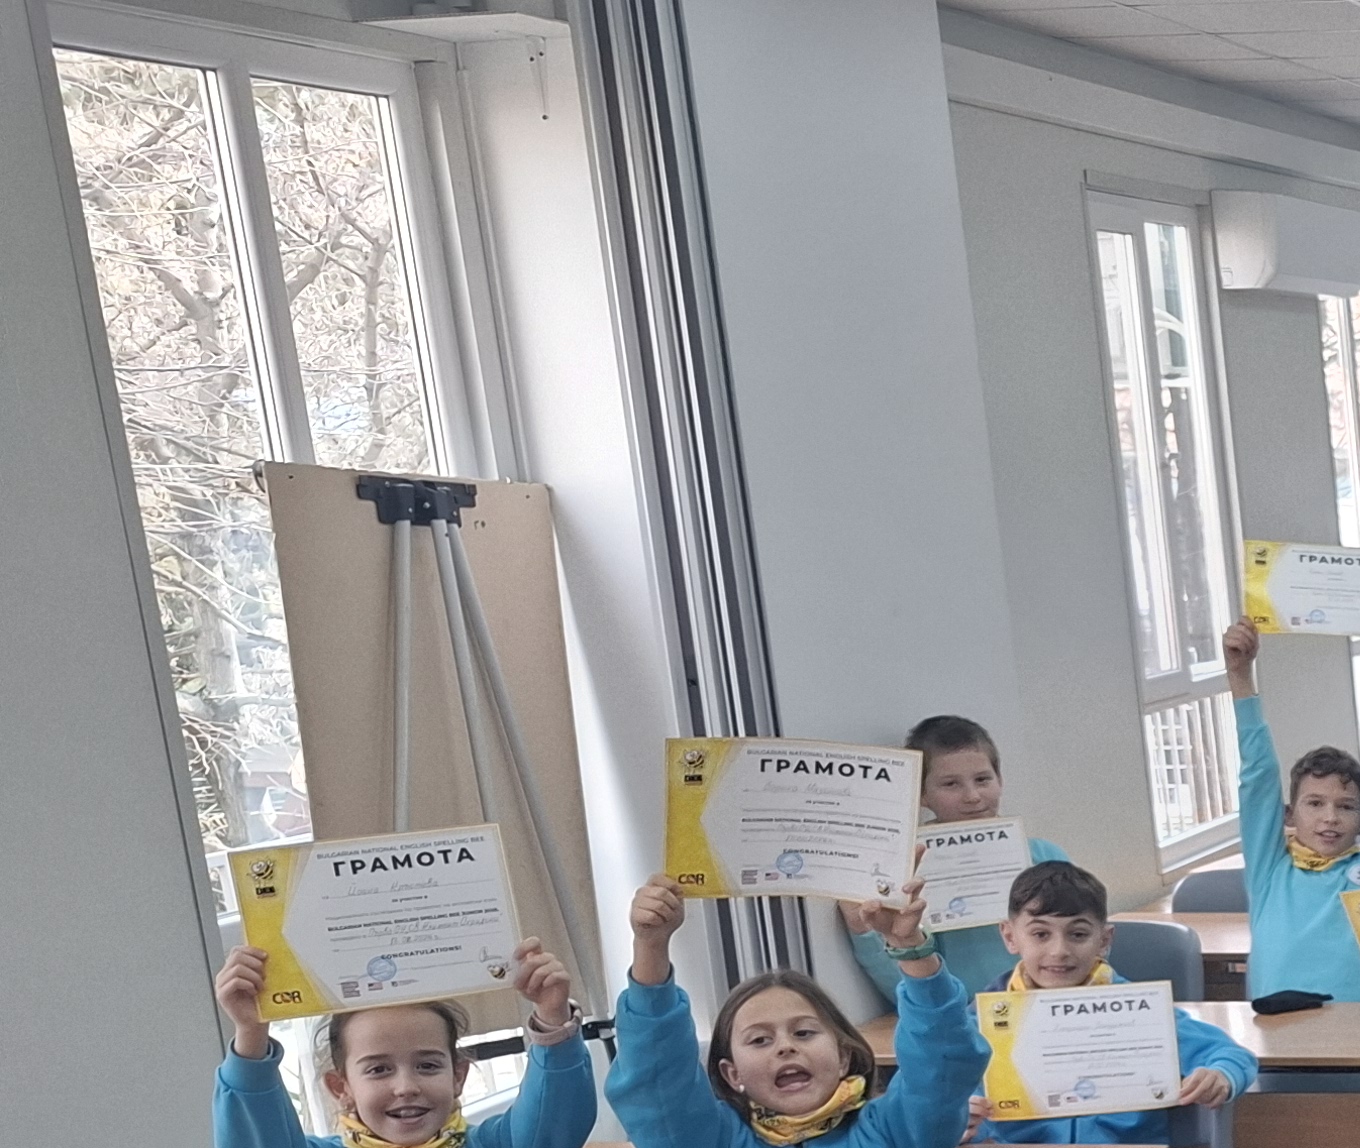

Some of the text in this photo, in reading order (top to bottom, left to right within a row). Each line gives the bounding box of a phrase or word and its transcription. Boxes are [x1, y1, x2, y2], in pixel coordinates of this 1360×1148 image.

[760, 759, 891, 782] ГРАМОТА
[926, 830, 1008, 848] ГРАМОТА
[333, 847, 475, 876] ГРАМОТА
[1051, 998, 1151, 1016] ГРАМОТА
